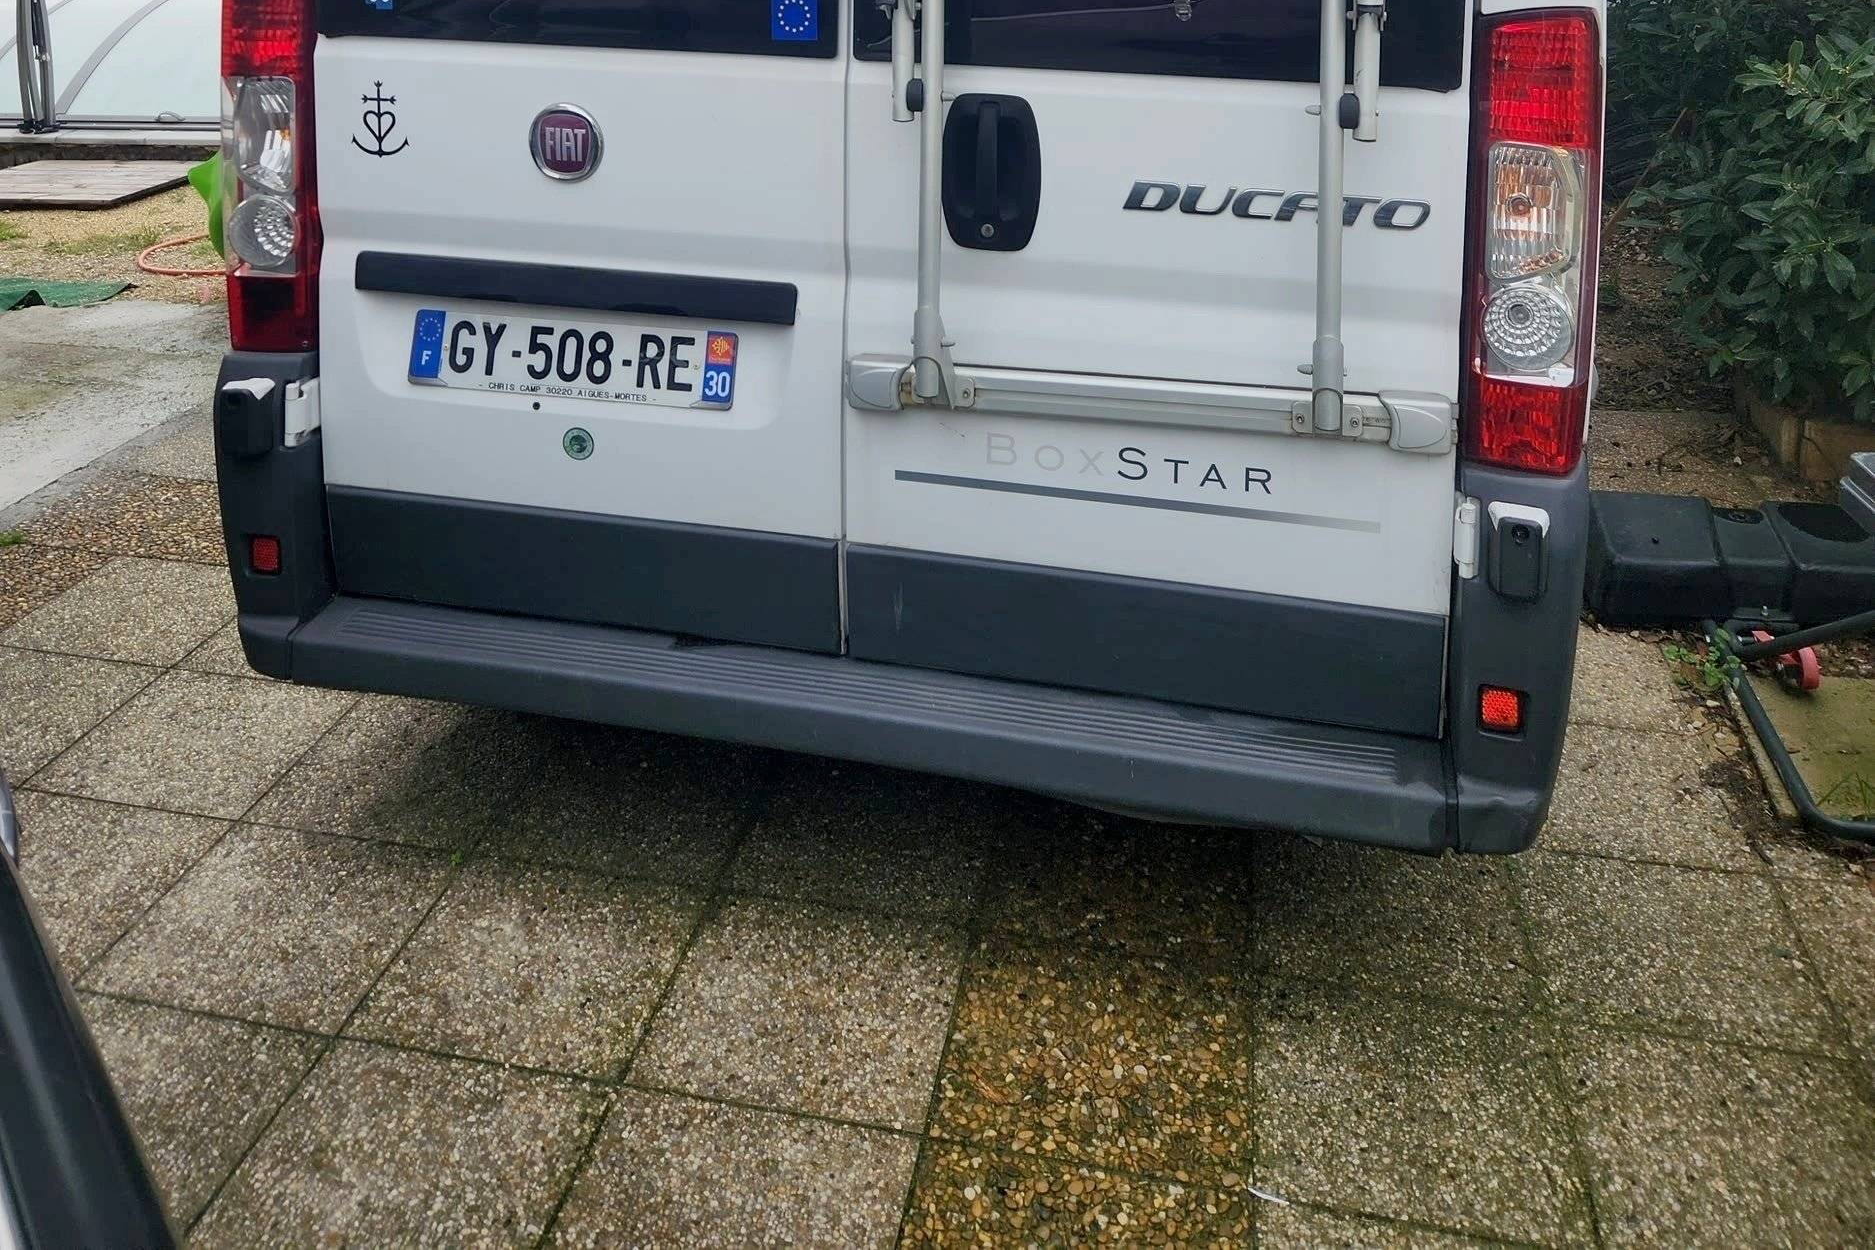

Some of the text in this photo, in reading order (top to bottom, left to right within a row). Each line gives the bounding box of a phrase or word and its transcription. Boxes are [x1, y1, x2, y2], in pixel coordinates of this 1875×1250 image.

[544, 126, 587, 163] FIAT
[1122, 179, 1432, 231] DUCATO
[421, 350, 432, 366] F
[448, 319, 696, 392] GY-508-RE
[488, 381, 647, 402] CHRIS CAMP 30220 AIGUES-MORTES
[704, 370, 731, 398] 30
